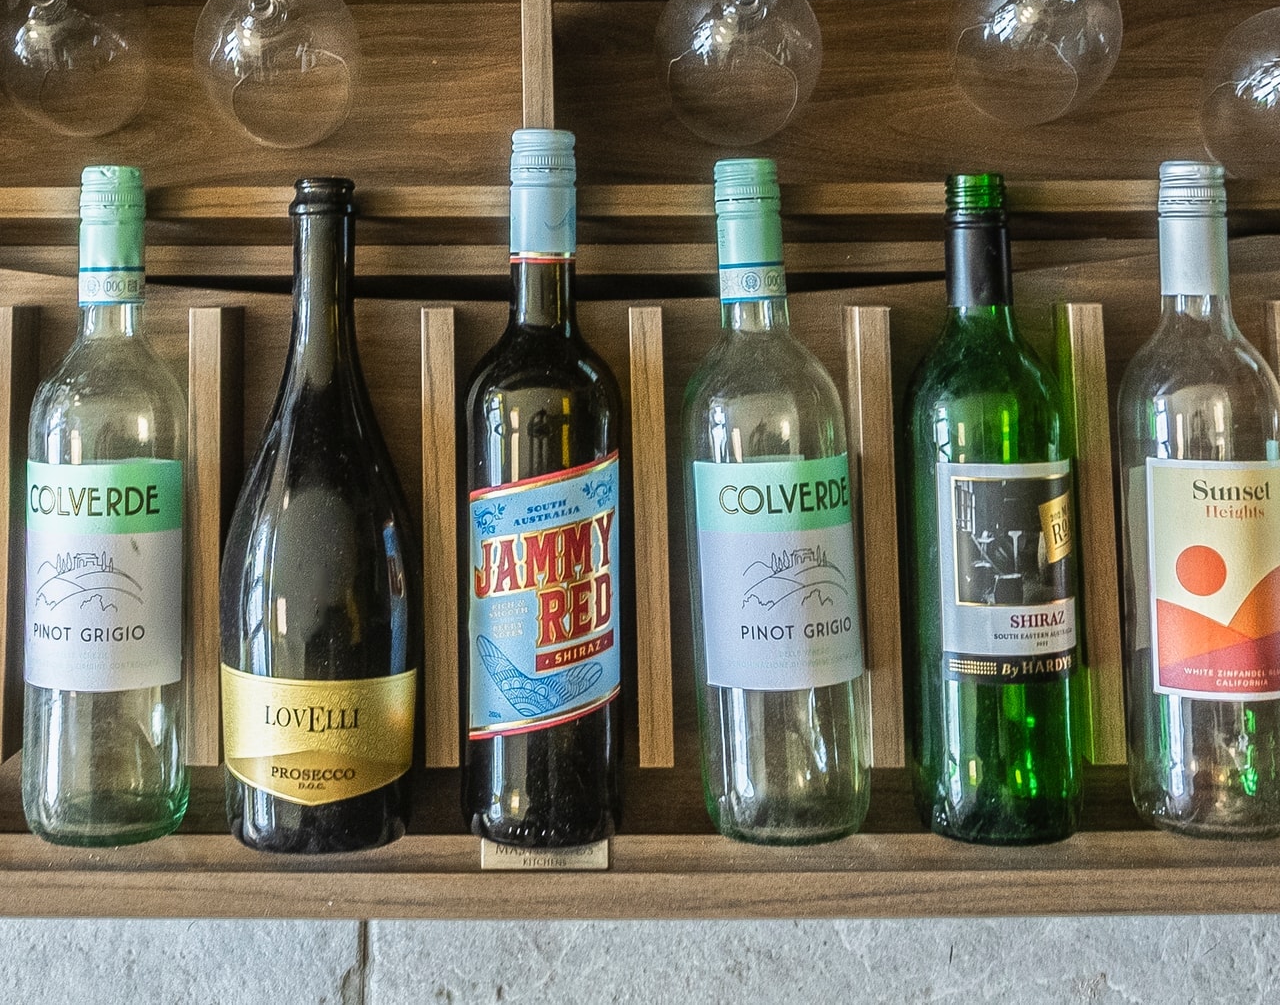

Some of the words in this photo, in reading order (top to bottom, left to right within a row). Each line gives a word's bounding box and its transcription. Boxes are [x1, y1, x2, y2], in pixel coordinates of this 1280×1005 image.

[31, 484, 160, 516] COLVERDE
[720, 476, 849, 514] COLVERDE
[1192, 479, 1271, 502] Sunset
[526, 499, 567, 514] SOUTH
[1205, 504, 1265, 521] Heights
[513, 506, 581, 527] AUSTRALIA
[474, 506, 616, 599] JAMMY
[536, 572, 615, 648] RED
[1010, 610, 1065, 629] SHIRAZ
[34, 623, 71, 642] PINOT
[81, 625, 145, 642] GRIGIO
[742, 624, 795, 640] PINOT
[804, 616, 852, 639] GRIGIO
[1020, 632, 1049, 640] EASTERN
[555, 643, 600, 664] SHIRAZ
[1001, 663, 1019, 679] By
[1183, 667, 1213, 676] WHITE
[1217, 668, 1266, 678] ZINFANDEL
[1216, 678, 1269, 687] CALIFORNIA
[271, 766, 356, 781] PROSECCO
